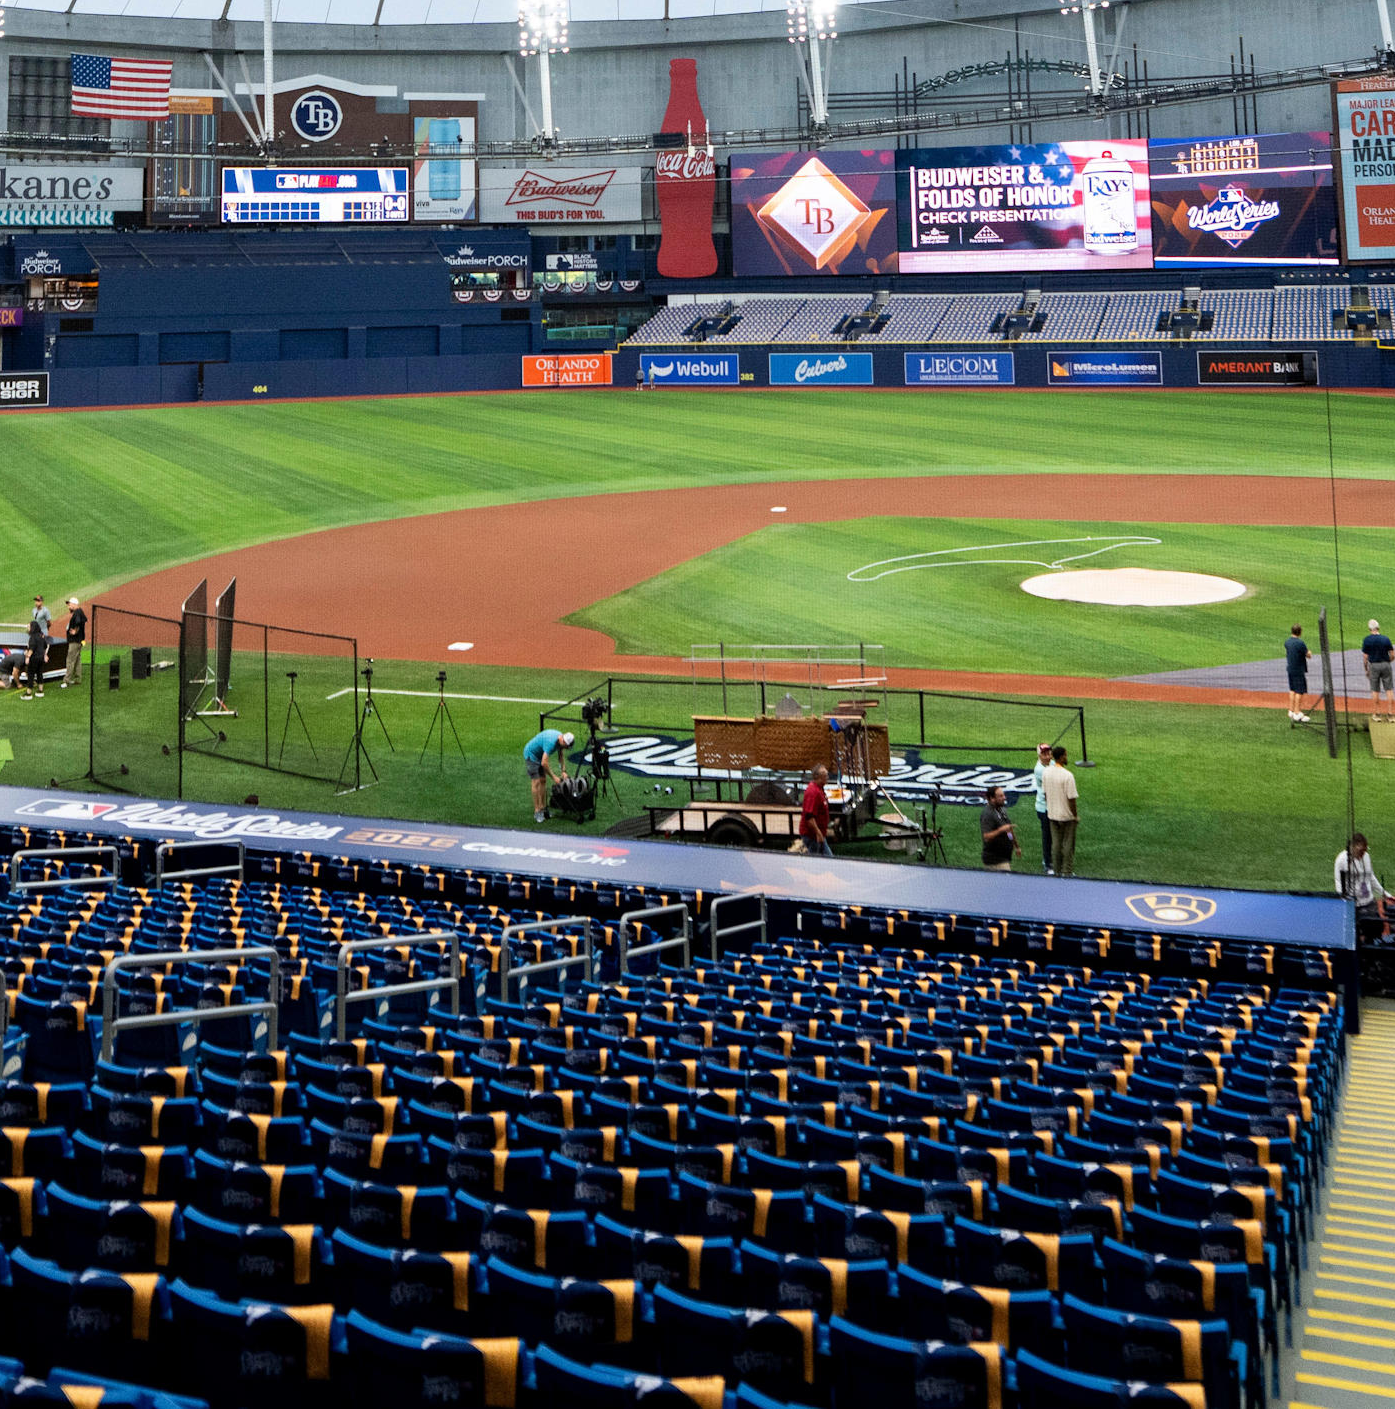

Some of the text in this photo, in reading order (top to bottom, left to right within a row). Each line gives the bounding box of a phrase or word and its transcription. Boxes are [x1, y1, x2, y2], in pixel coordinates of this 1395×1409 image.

[1349, 99, 1378, 109] MAJOR
[918, 166, 1045, 188] BUDWEISER &
[515, 178, 607, 198] Budweiser
[918, 186, 1076, 209] FOLDS OF HONOR
[516, 209, 606, 220] THIS BUD'S FOR YOU.
[795, 199, 835, 235] TB
[919, 207, 1078, 225] CHECK PRESENTATION
[488, 255, 528, 266] PORCH
[20, 264, 61, 275] PORCH
[535, 358, 599, 370] ORLANDO
[676, 360, 729, 377] Webull
[794, 355, 847, 383] Culver's
[1073, 362, 1157, 371] MicroLumen
[1208, 362, 1300, 373] AMERANT BANK
[543, 370, 593, 383] HEALTH
[741, 373, 754, 381] 382
[253, 384, 268, 393] 404
